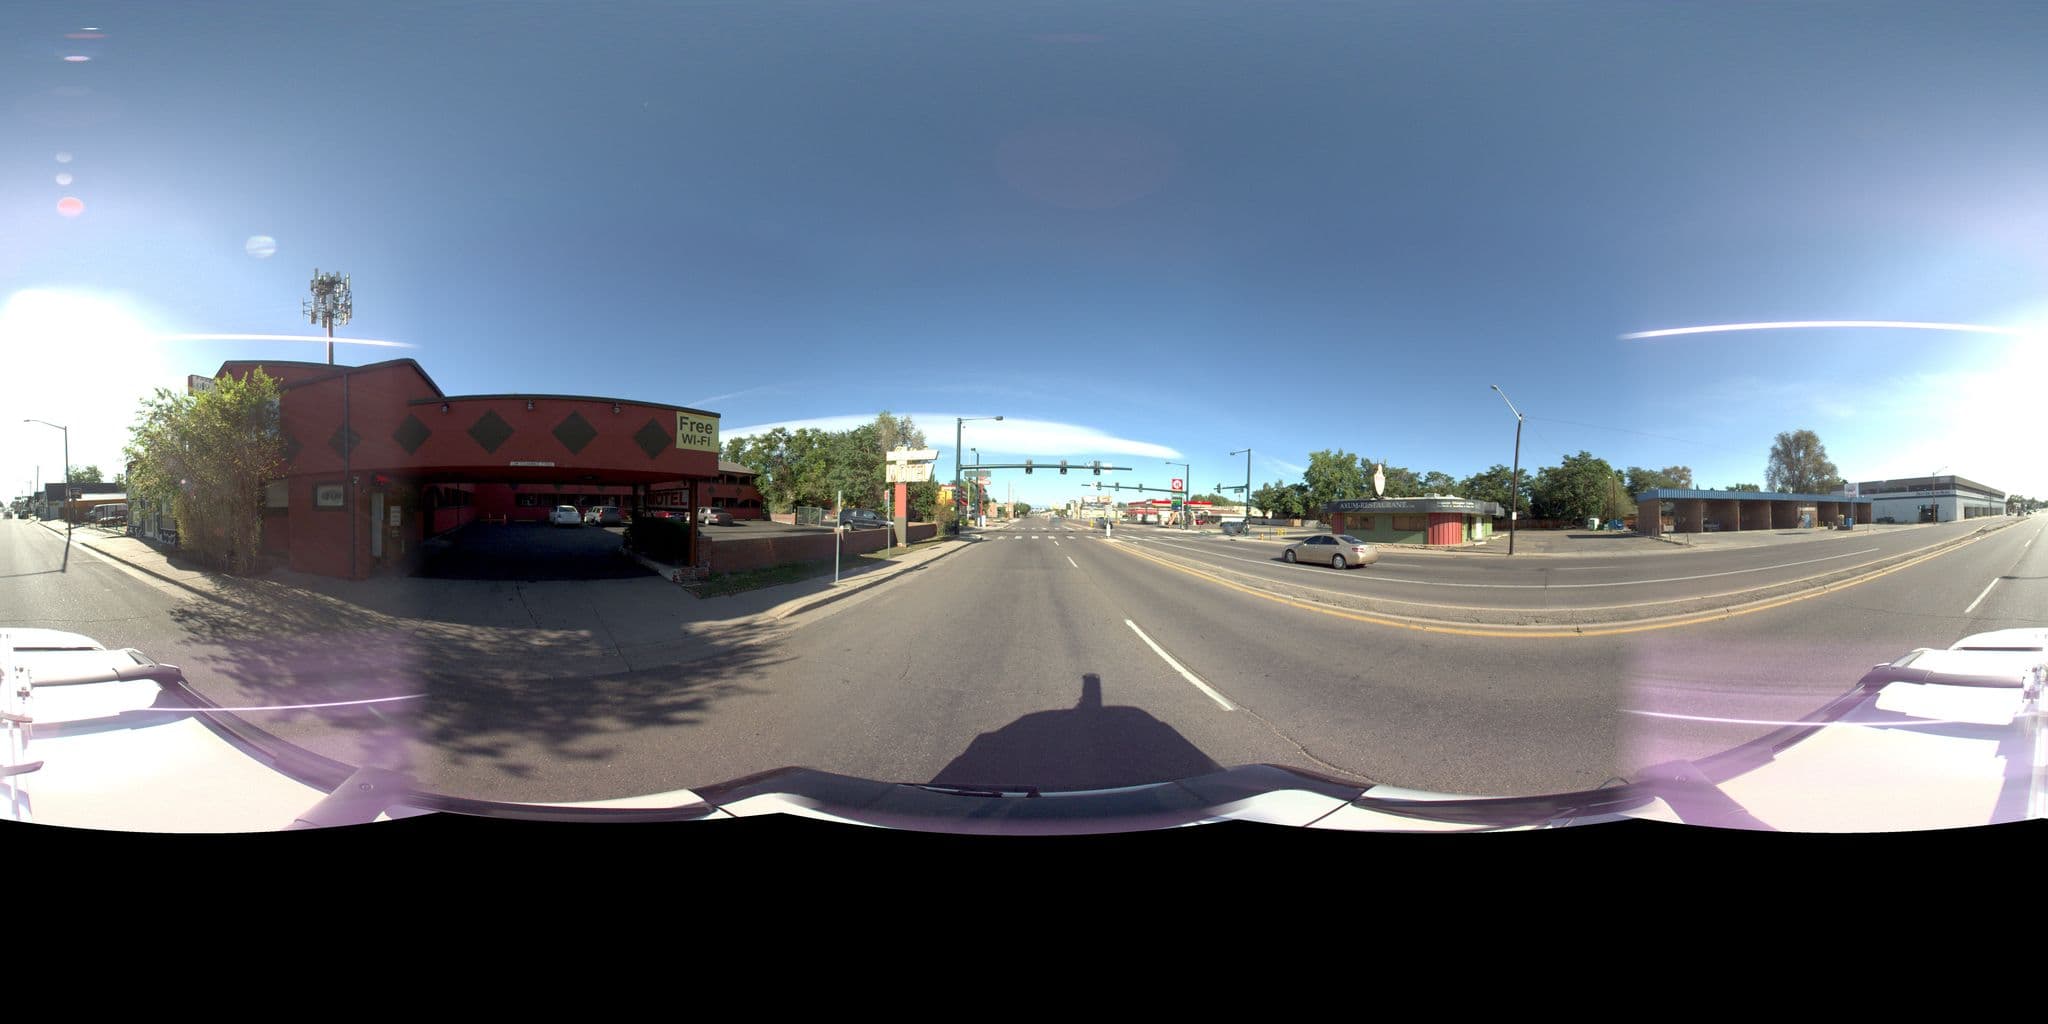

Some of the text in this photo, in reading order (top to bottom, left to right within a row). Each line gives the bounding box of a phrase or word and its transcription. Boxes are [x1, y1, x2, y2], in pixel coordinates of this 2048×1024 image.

[680, 416, 713, 434] Free
[682, 433, 711, 447] WI-FI
[647, 492, 687, 506] MOTEL
